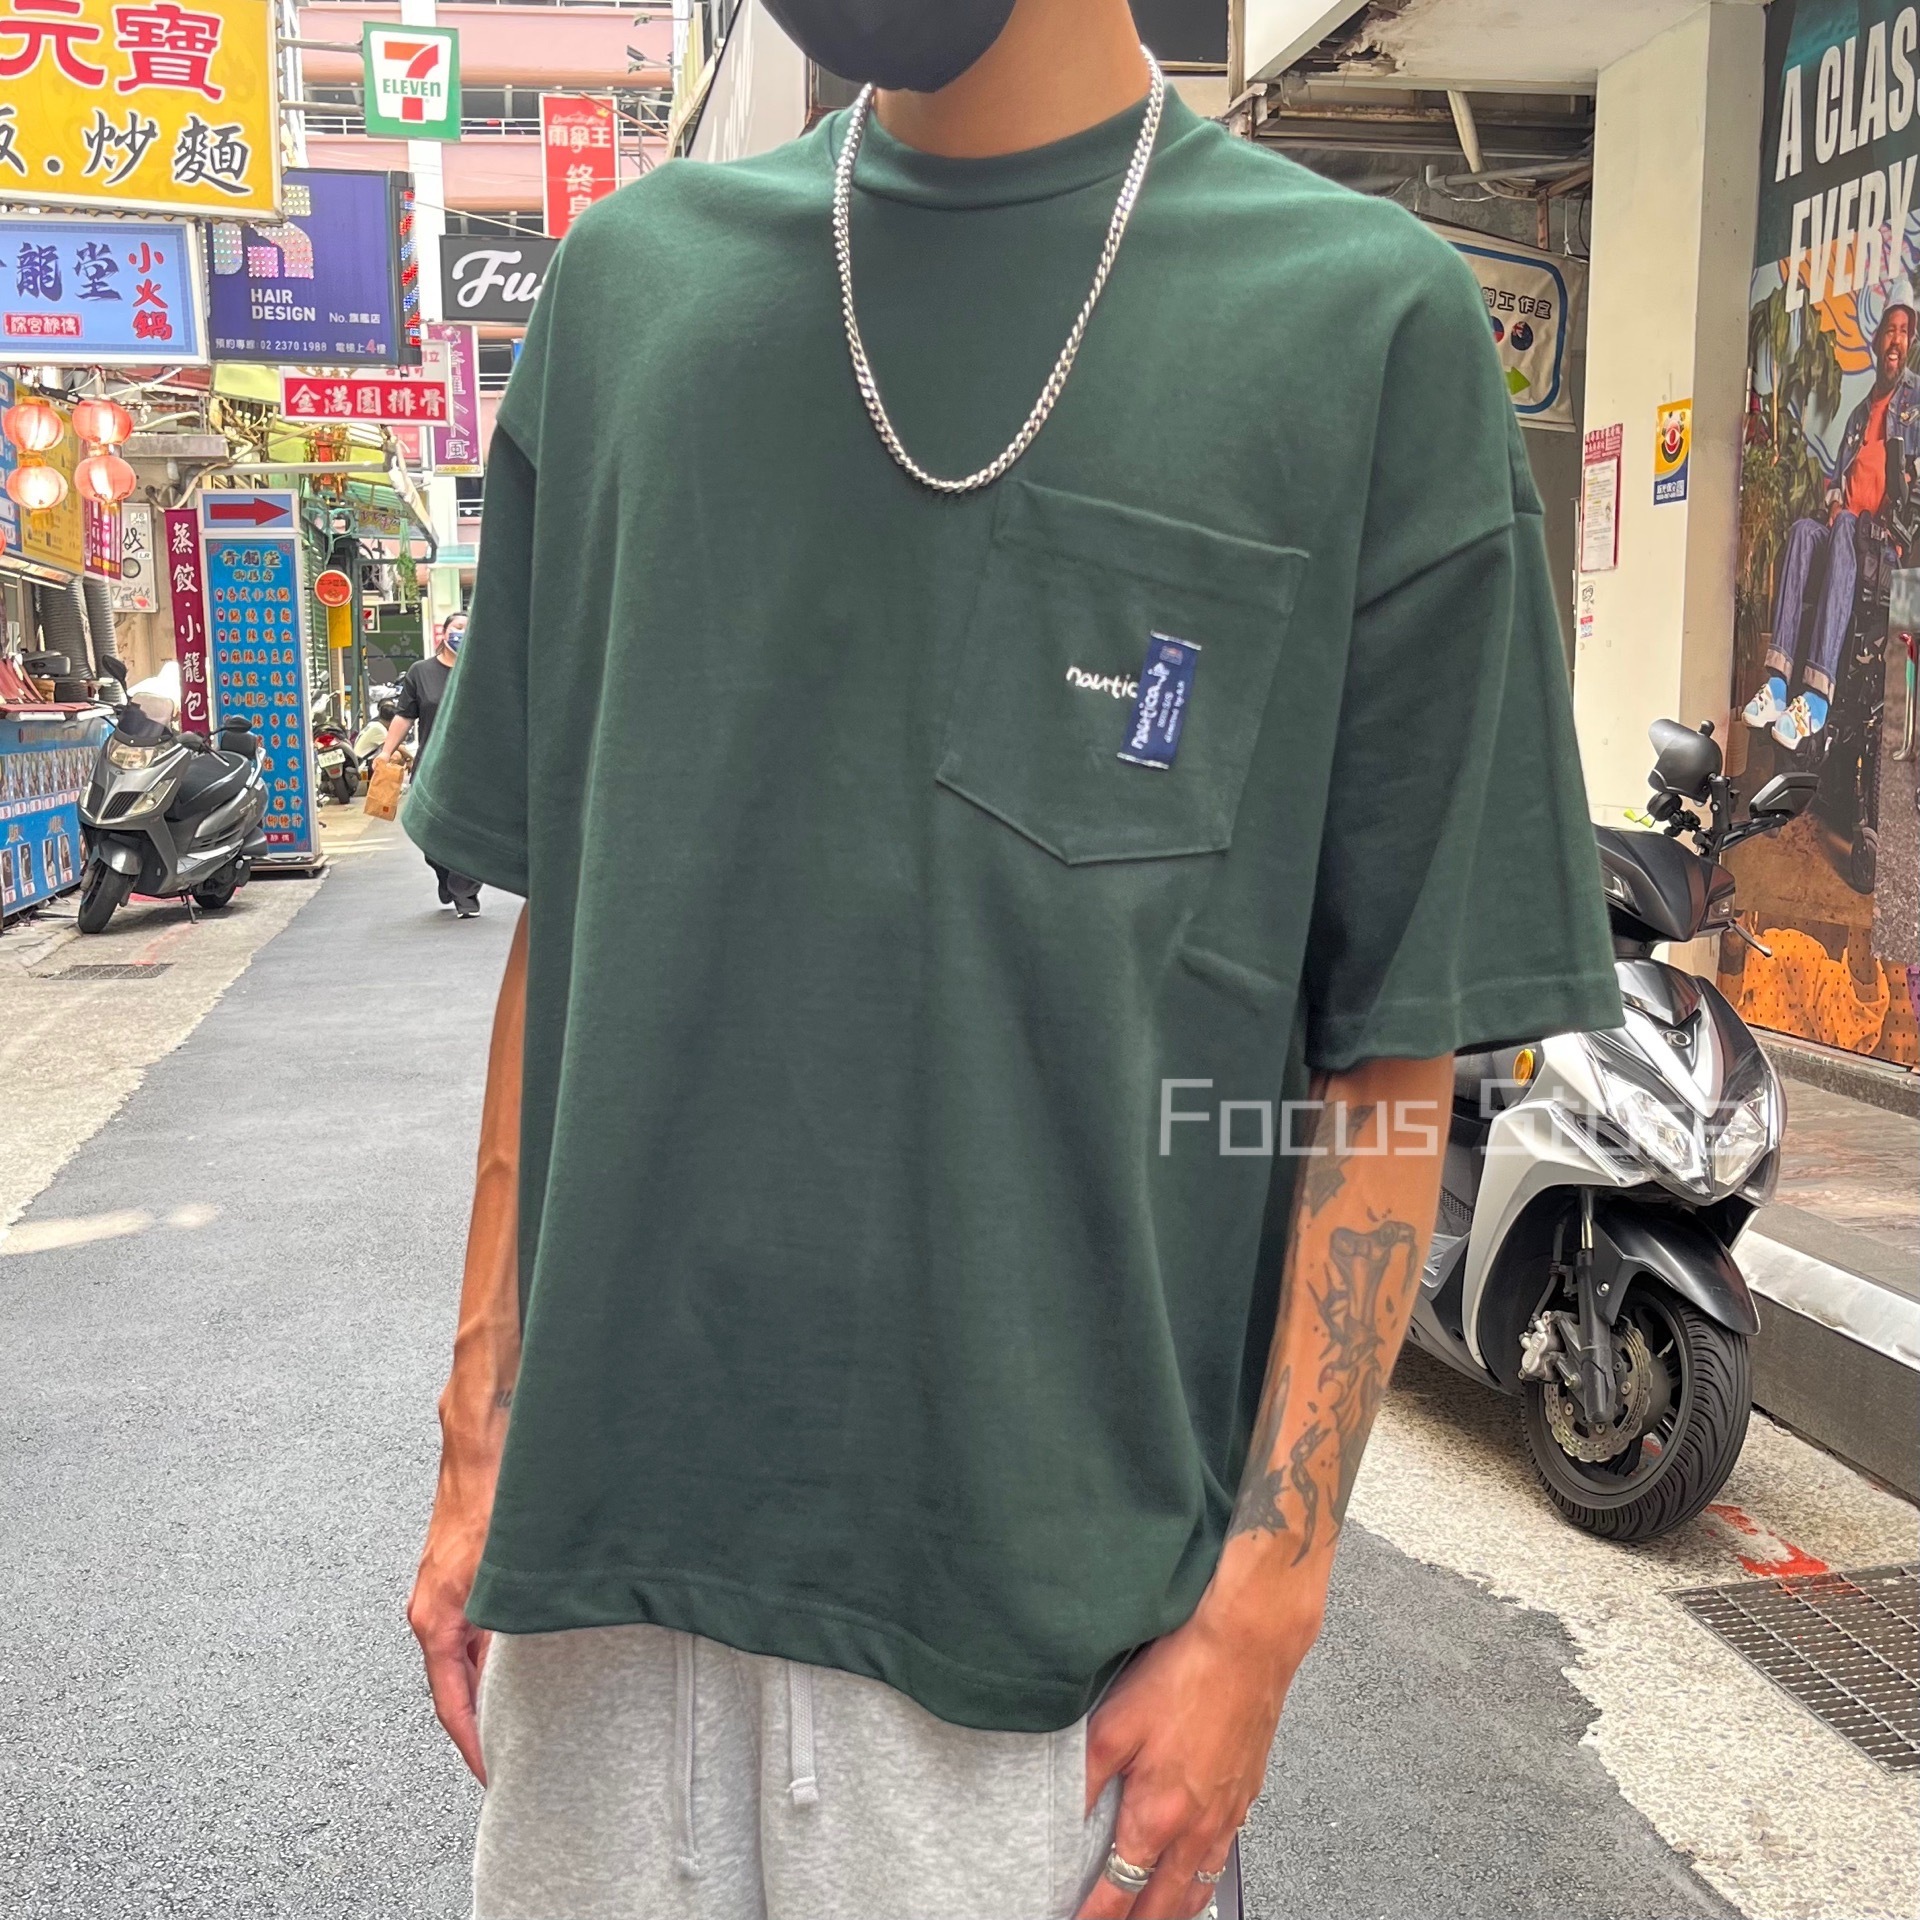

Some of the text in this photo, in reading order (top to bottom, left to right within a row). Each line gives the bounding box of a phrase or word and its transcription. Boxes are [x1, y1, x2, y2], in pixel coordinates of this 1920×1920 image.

[384, 41, 439, 121] 7
[1775, 6, 1920, 183] A CLAS
[1785, 154, 1918, 313] EVERY
[0, 242, 122, 302] 龍堂
[128, 242, 172, 342] 小火鍋
[251, 288, 294, 304] HAIR
[452, 250, 547, 308] Fu
[252, 305, 316, 322] DESIGN
[275, 340, 300, 351] 2370
[302, 342, 327, 352] 1988
[290, 384, 446, 418] 金滿園排骨
